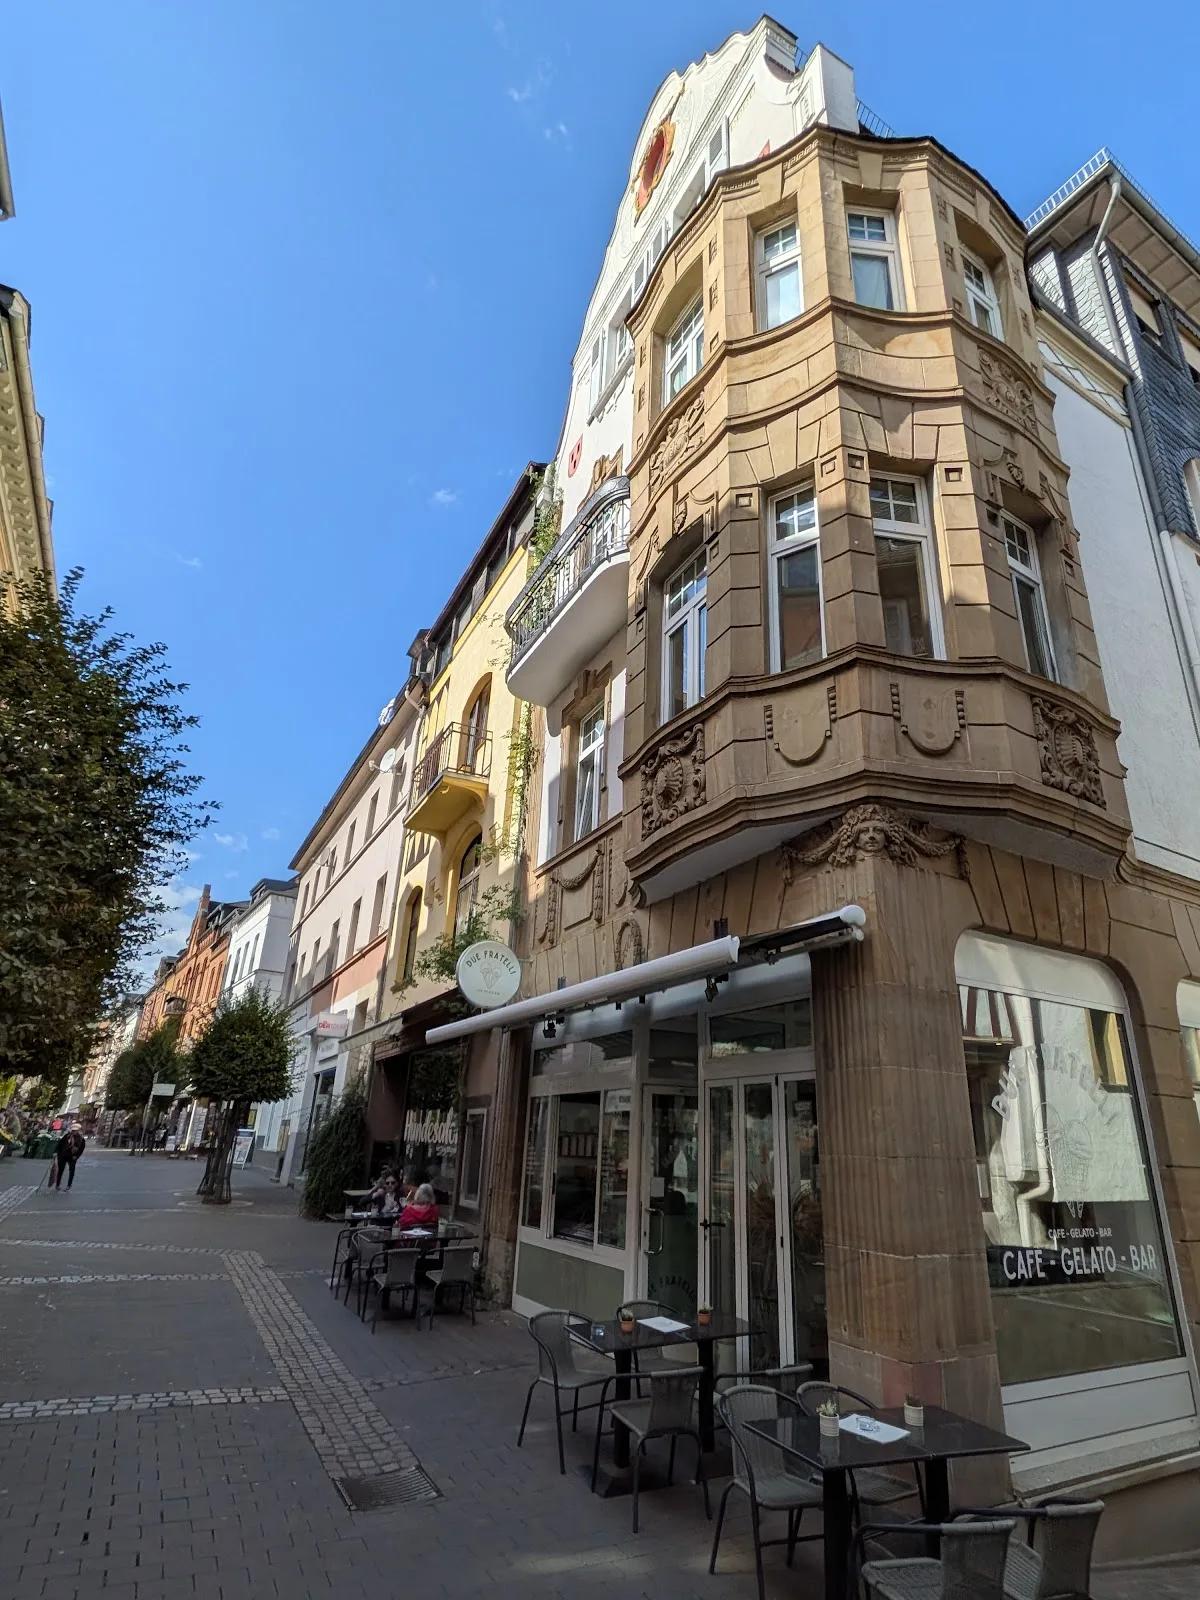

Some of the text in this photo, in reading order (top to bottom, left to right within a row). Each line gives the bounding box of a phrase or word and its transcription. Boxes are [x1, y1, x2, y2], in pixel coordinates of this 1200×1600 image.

[466, 950, 517, 975] DUE FRATELLI
[1048, 1228, 1065, 1239] CAFE
[1070, 1227, 1095, 1239] GELATO
[1099, 1227, 1113, 1238] BAR
[1003, 1250, 1046, 1280] CAFE
[1061, 1246, 1117, 1276] GELATO
[1129, 1244, 1158, 1271] BAR
